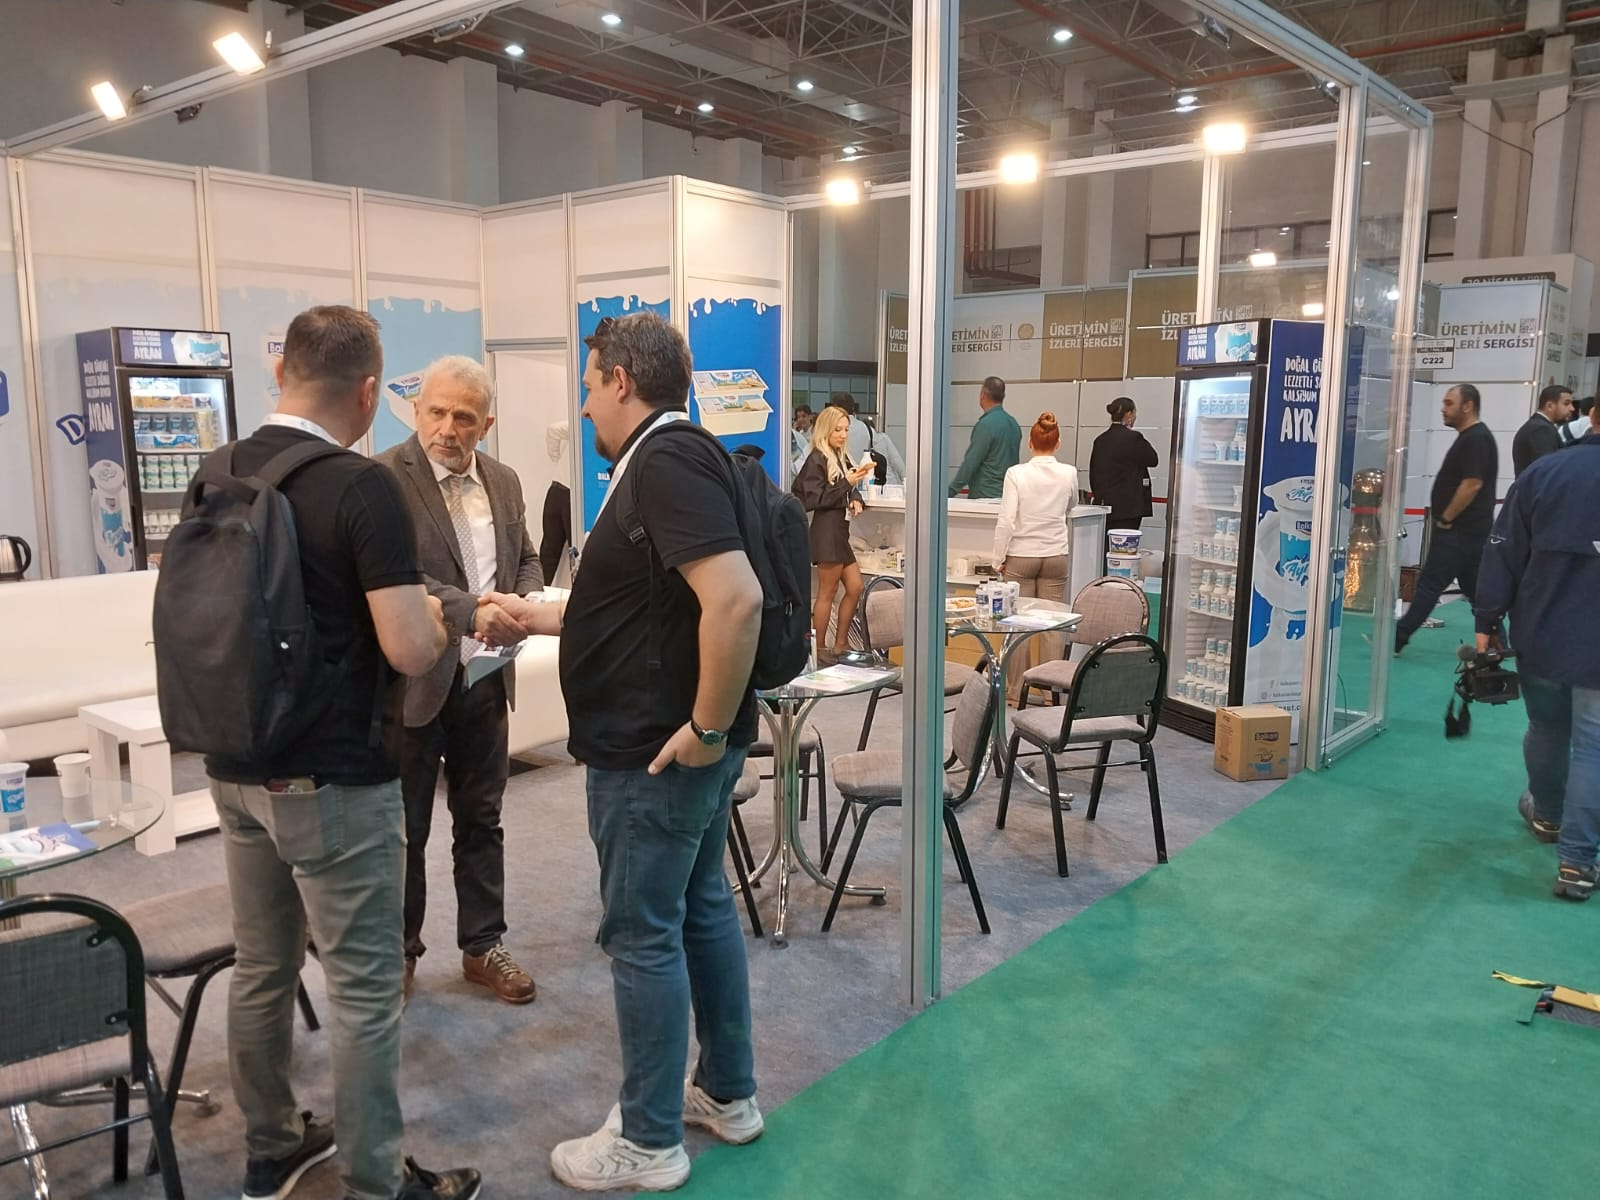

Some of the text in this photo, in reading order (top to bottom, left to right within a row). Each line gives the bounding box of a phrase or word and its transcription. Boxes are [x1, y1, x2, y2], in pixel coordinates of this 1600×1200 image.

[1161, 309, 1233, 325] ÜRETİN
[890, 326, 908, 340] ÜRET
[952, 326, 990, 341] ETİMİN
[1050, 320, 1108, 336] ÜRETİMİN
[1161, 328, 1179, 340] İZL
[1441, 321, 1517, 336] ÜRETİMİN
[890, 341, 908, 352] İZLER
[952, 340, 1002, 353] ERİ SERGİSİ
[1050, 334, 1123, 349] İZLERİ SERGİSİ
[1483, 336, 1536, 349] SERGİSİ
[1285, 355, 1310, 373] DOĞAL
[1422, 357, 1444, 365] C222
[1284, 375, 1313, 388] LEZZETLİ
[1283, 389, 1317, 403] KALSİYUM
